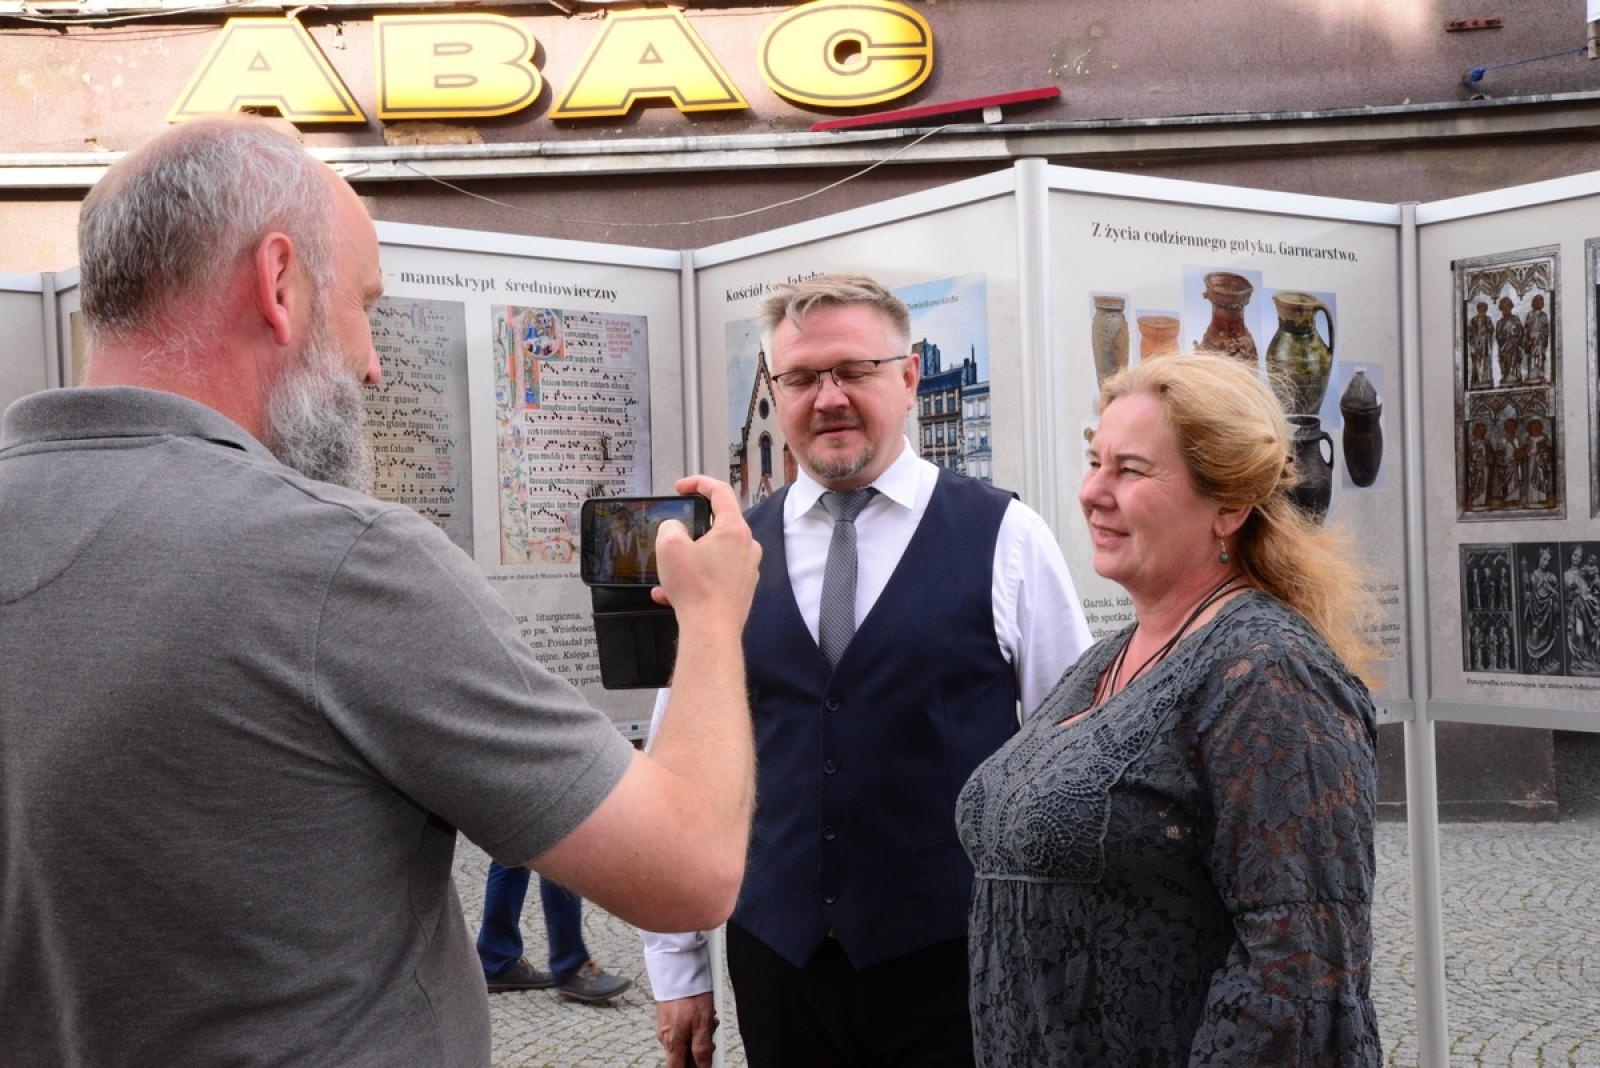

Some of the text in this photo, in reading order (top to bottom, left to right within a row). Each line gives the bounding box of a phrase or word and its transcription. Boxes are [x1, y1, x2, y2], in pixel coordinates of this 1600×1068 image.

[165, 0, 934, 123] ABAC
[1091, 221, 1358, 262] Z życia codziennego gotyku. Garncarstwo.
[400, 271, 497, 293] manuskrypt
[505, 278, 618, 303] średniowieczny
[726, 282, 763, 303] Kościół
[551, 625, 595, 634] Wniebowz
[575, 663, 583, 671] W
